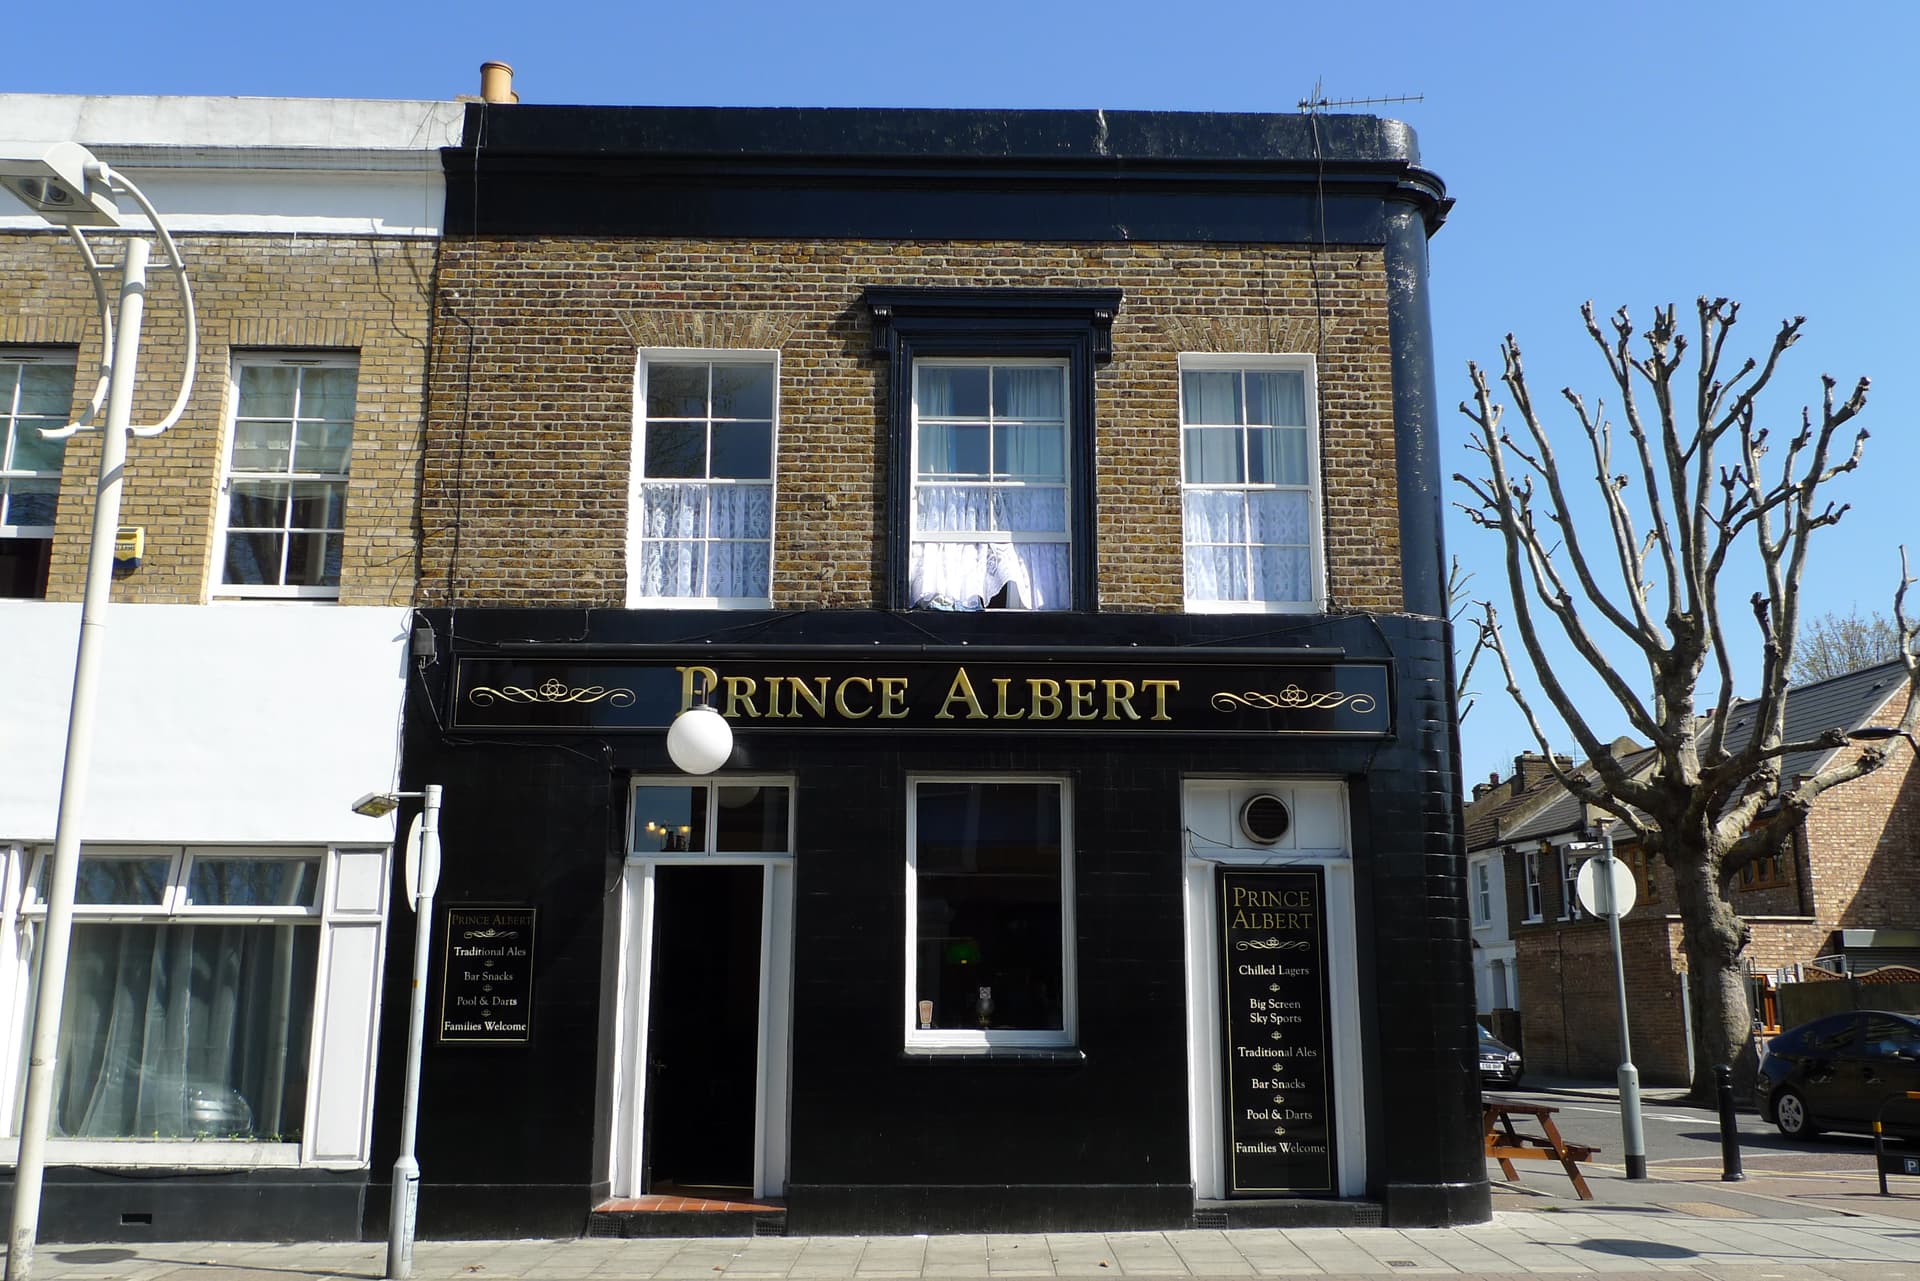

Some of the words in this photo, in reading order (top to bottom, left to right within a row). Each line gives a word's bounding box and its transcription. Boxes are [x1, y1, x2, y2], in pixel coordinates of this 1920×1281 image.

[675, 666, 910, 719] PRINCE
[934, 666, 1180, 720] ALBERT
[1233, 887, 1311, 907] PRINCE
[452, 914, 489, 925] PRINCE
[492, 914, 531, 925] ALBERT
[1231, 909, 1313, 929] ALBERT
[453, 946, 504, 956] Traditional
[506, 946, 527, 956] Ales
[464, 971, 480, 981] Bar
[482, 971, 513, 981] Snacks
[1238, 964, 1275, 975] Chilled
[1278, 965, 1309, 977] Lagers
[457, 996, 477, 1006] Pool
[479, 997, 488, 1006] &
[492, 996, 518, 1006] Darts
[1249, 998, 1266, 1010] Big
[1268, 999, 1301, 1009] Screen
[1249, 1013, 1268, 1025] Sky
[1270, 1013, 1302, 1025] Sports
[444, 1021, 481, 1031] Families
[484, 1021, 527, 1031] Welcome
[1237, 1046, 1293, 1057] Traditional
[1295, 1046, 1317, 1057] Ales
[1251, 1078, 1270, 1089] Bar
[1271, 1078, 1306, 1089] Snacks
[1246, 1109, 1269, 1120] Pool
[1271, 1109, 1282, 1120] &
[1285, 1109, 1313, 1120] Darts
[1235, 1142, 1277, 1153] Families
[1279, 1142, 1326, 1153] Welcome
[1907, 1160, 1916, 1172] P
